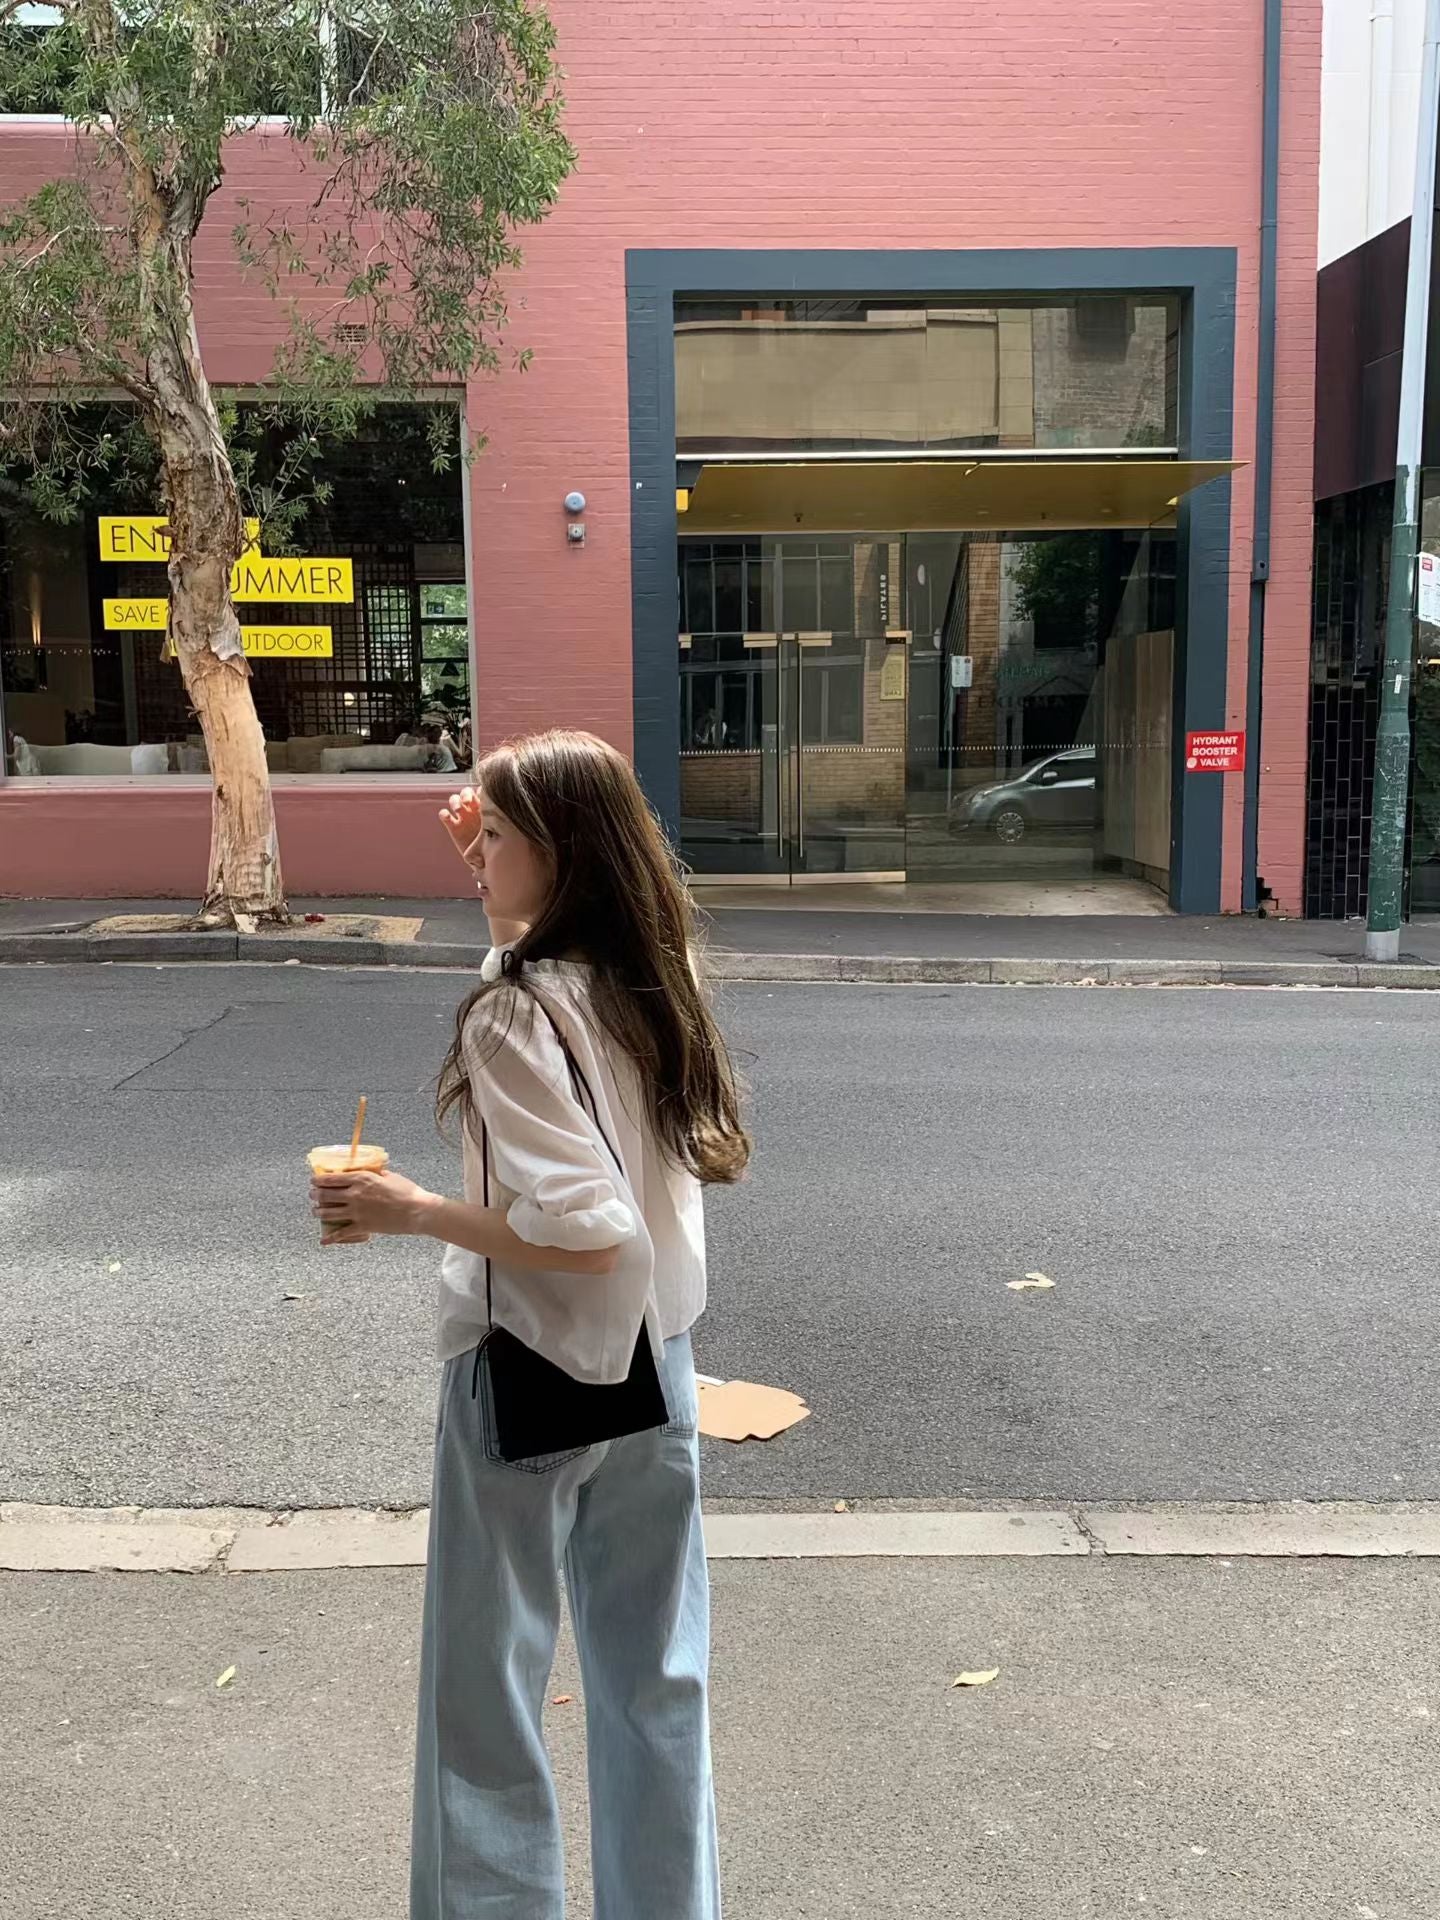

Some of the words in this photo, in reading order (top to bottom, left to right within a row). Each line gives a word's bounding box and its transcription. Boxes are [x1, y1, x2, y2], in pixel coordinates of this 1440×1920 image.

[230, 567, 344, 594] UMMER
[113, 605, 160, 623] SAVE
[242, 633, 324, 651] UTDOOR
[1192, 736, 1238, 745] HYDRANT
[1192, 747, 1238, 756] BOOSTER
[1200, 758, 1230, 766] VALVE
